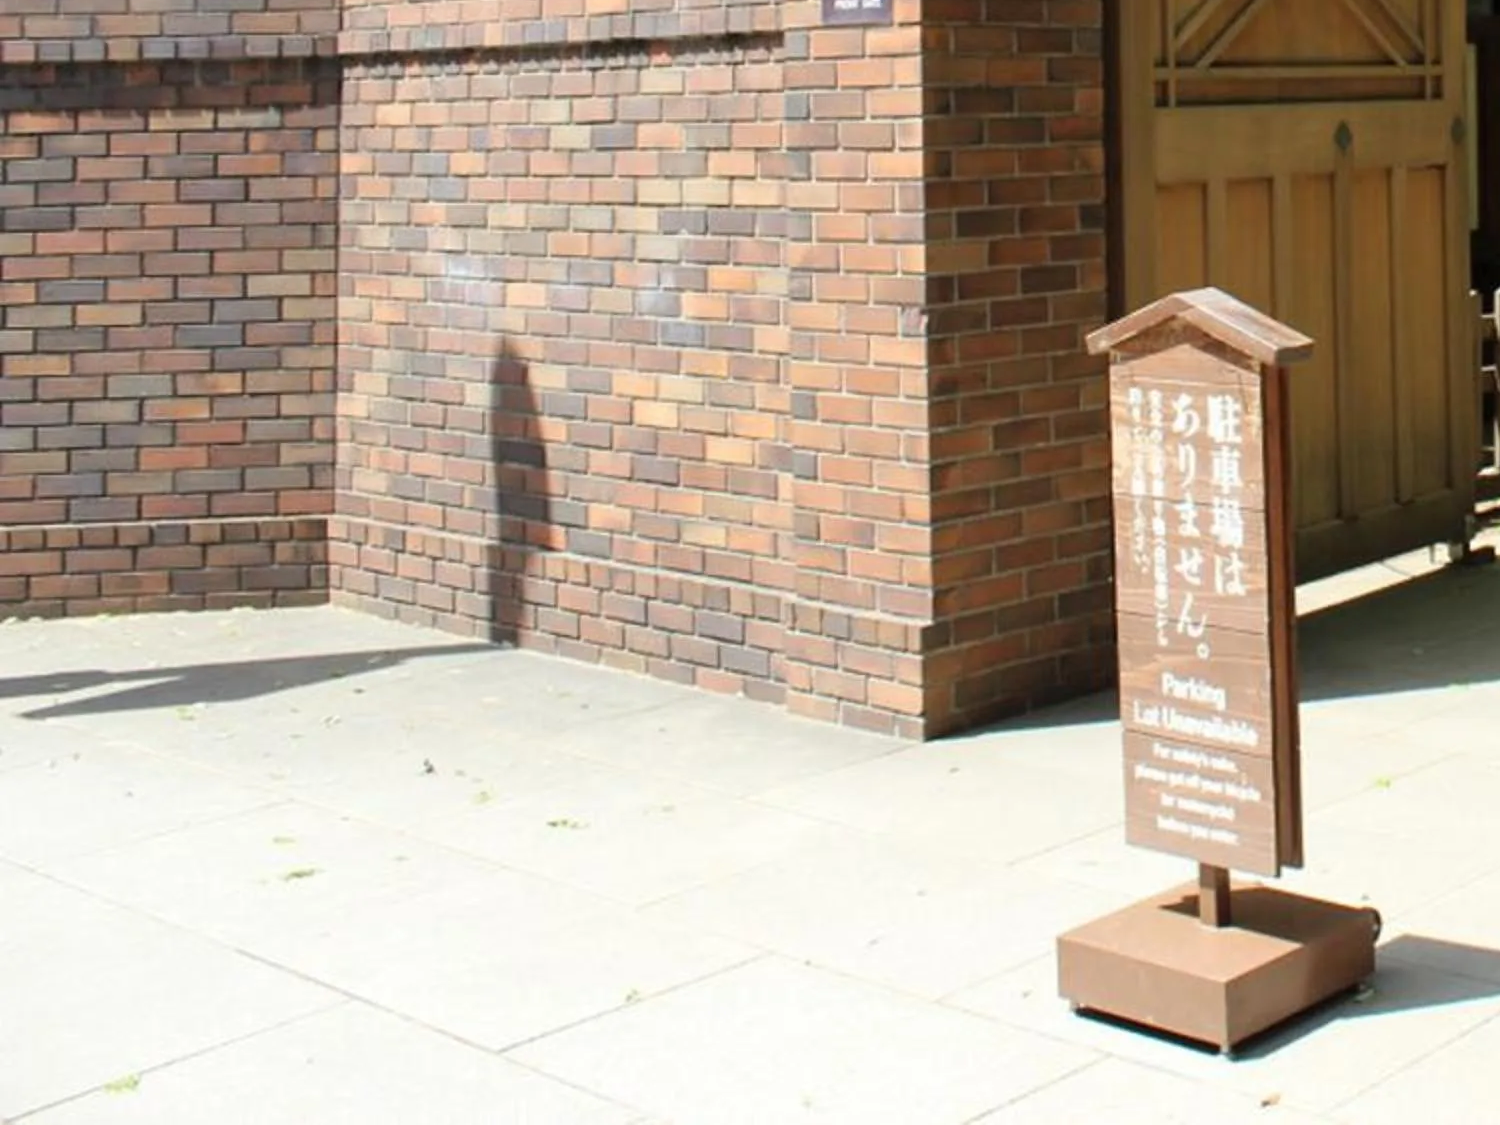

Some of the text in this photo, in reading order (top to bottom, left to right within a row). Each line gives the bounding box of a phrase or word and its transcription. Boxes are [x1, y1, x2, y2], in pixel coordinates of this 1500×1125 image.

[1170, 393, 1209, 660] ありません。
[1207, 394, 1247, 598] 駐車場は
[1133, 698, 1160, 728] Lot
[1161, 672, 1226, 711] Parking
